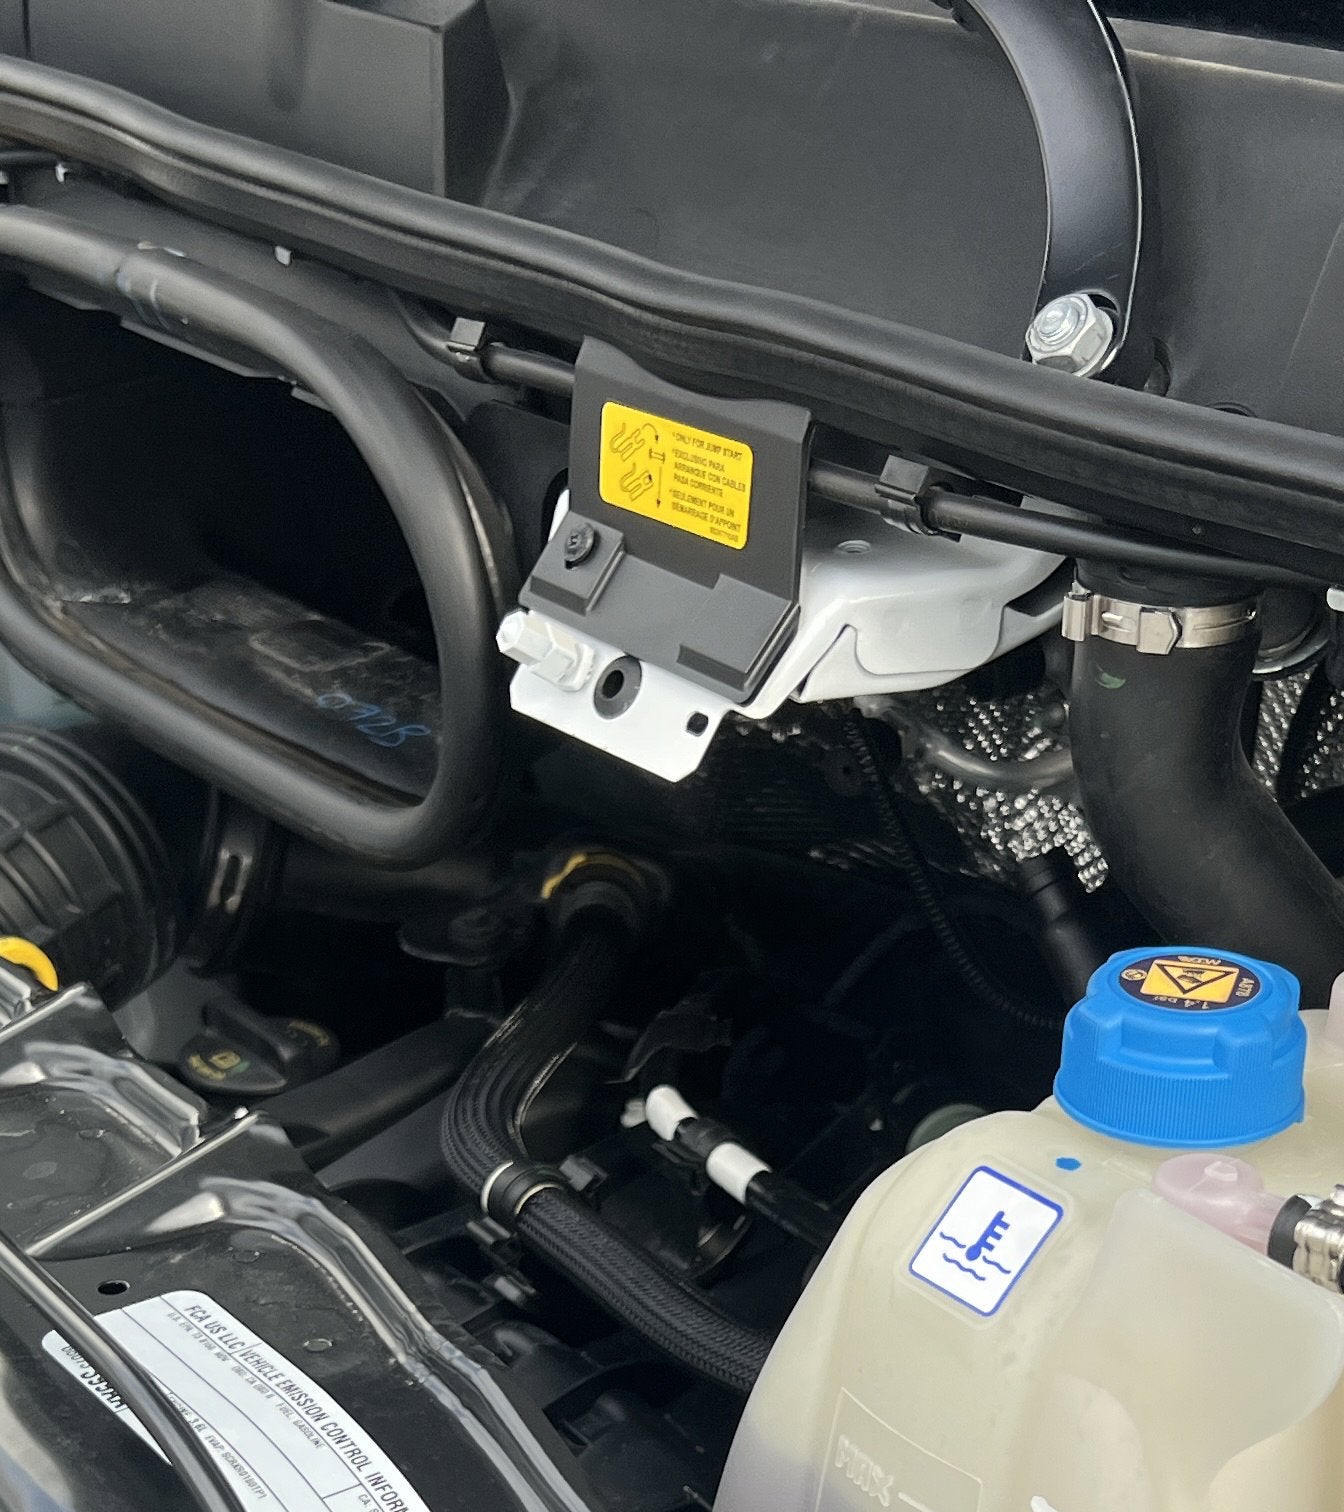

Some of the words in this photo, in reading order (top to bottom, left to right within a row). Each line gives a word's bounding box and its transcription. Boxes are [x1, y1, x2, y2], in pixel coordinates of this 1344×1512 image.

[692, 438, 704, 448] FOR
[706, 441, 721, 454] JUMP
[723, 446, 742, 461] START
[708, 471, 720, 484] CON
[722, 476, 746, 492] CABLES
[182, 1303, 211, 1323] FCA
[203, 1318, 227, 1334] US
[216, 1331, 245, 1351] LLC
[238, 1348, 285, 1382] VEHICLE
[274, 1378, 330, 1423] EMISSION
[318, 1420, 373, 1473] CONTROL
[834, 1433, 895, 1508] MAX
